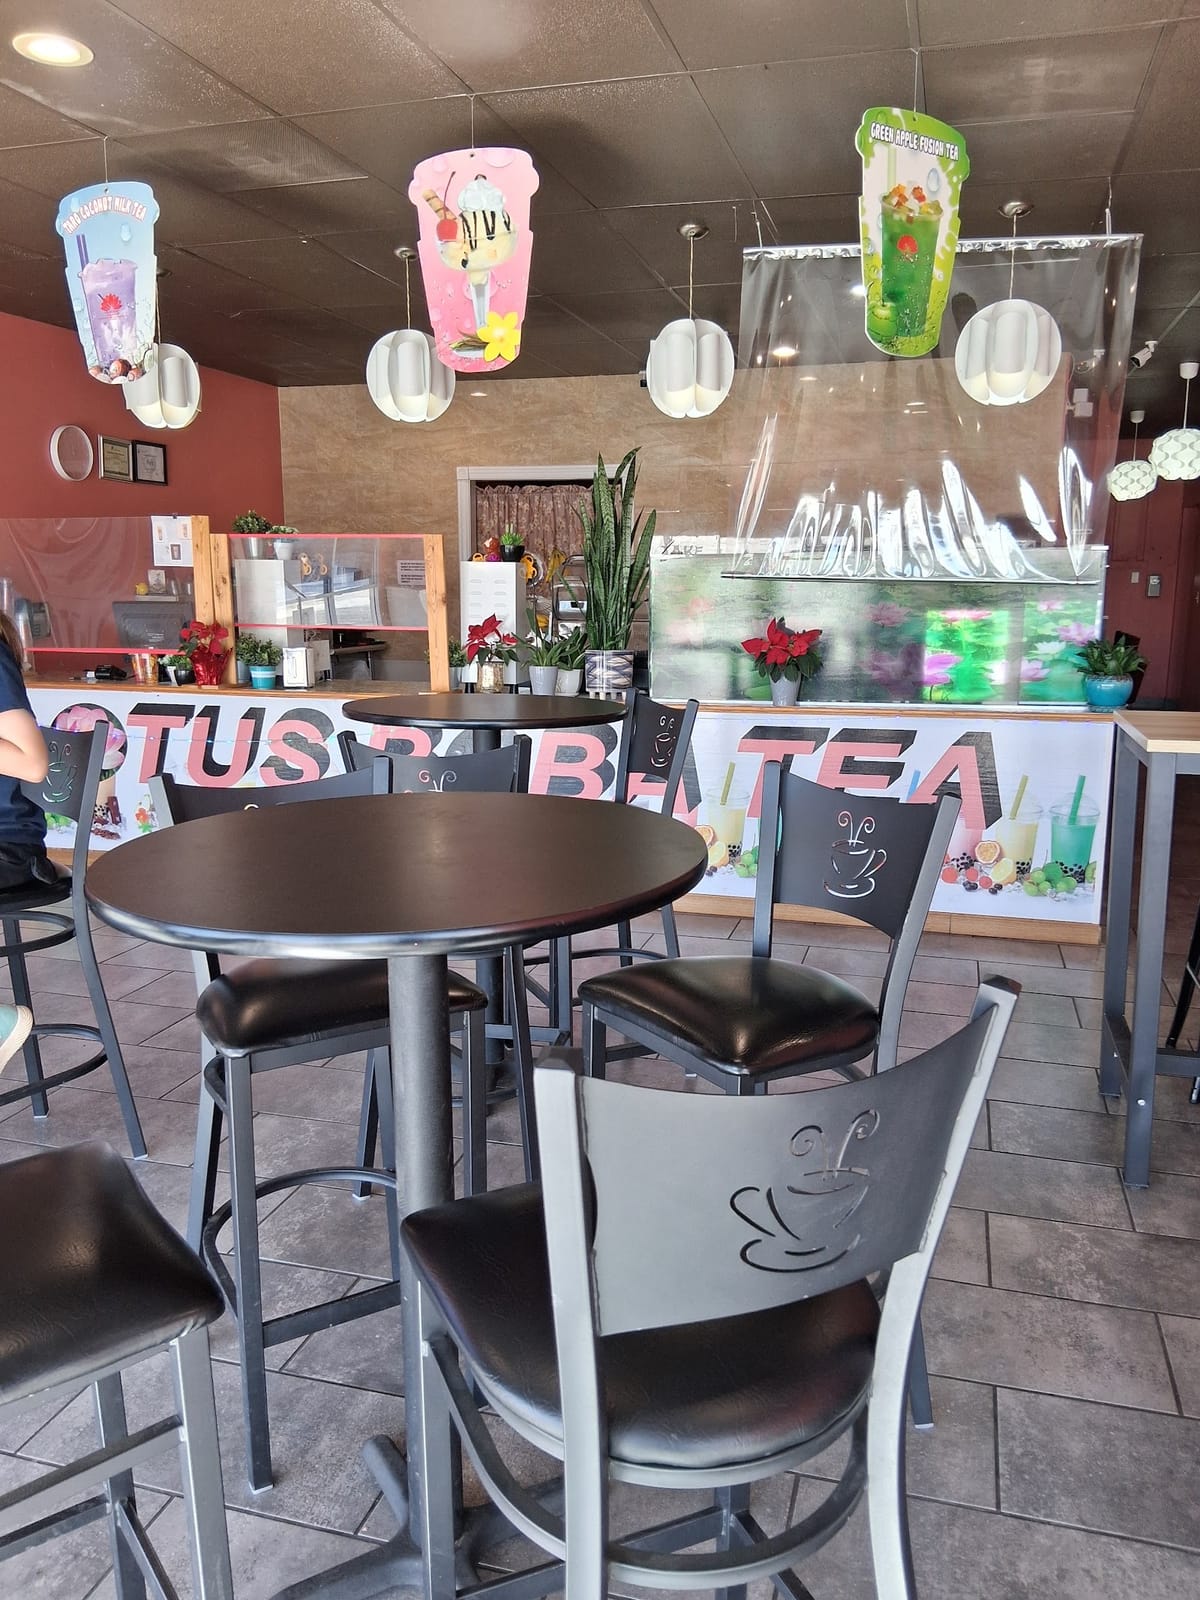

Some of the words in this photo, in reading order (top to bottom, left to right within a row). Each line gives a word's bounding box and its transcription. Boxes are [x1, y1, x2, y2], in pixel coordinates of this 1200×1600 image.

[870, 122, 894, 143] GREEN
[895, 129, 919, 150] APPLE
[920, 135, 945, 157] FUSION
[945, 143, 959, 161] TEA
[62, 211, 81, 234] TARO
[80, 196, 113, 220] COCONUT
[114, 196, 132, 214] MILK
[132, 201, 147, 221] TEA
[50, 702, 335, 788] OTUS
[737, 725, 1003, 830] TEA
